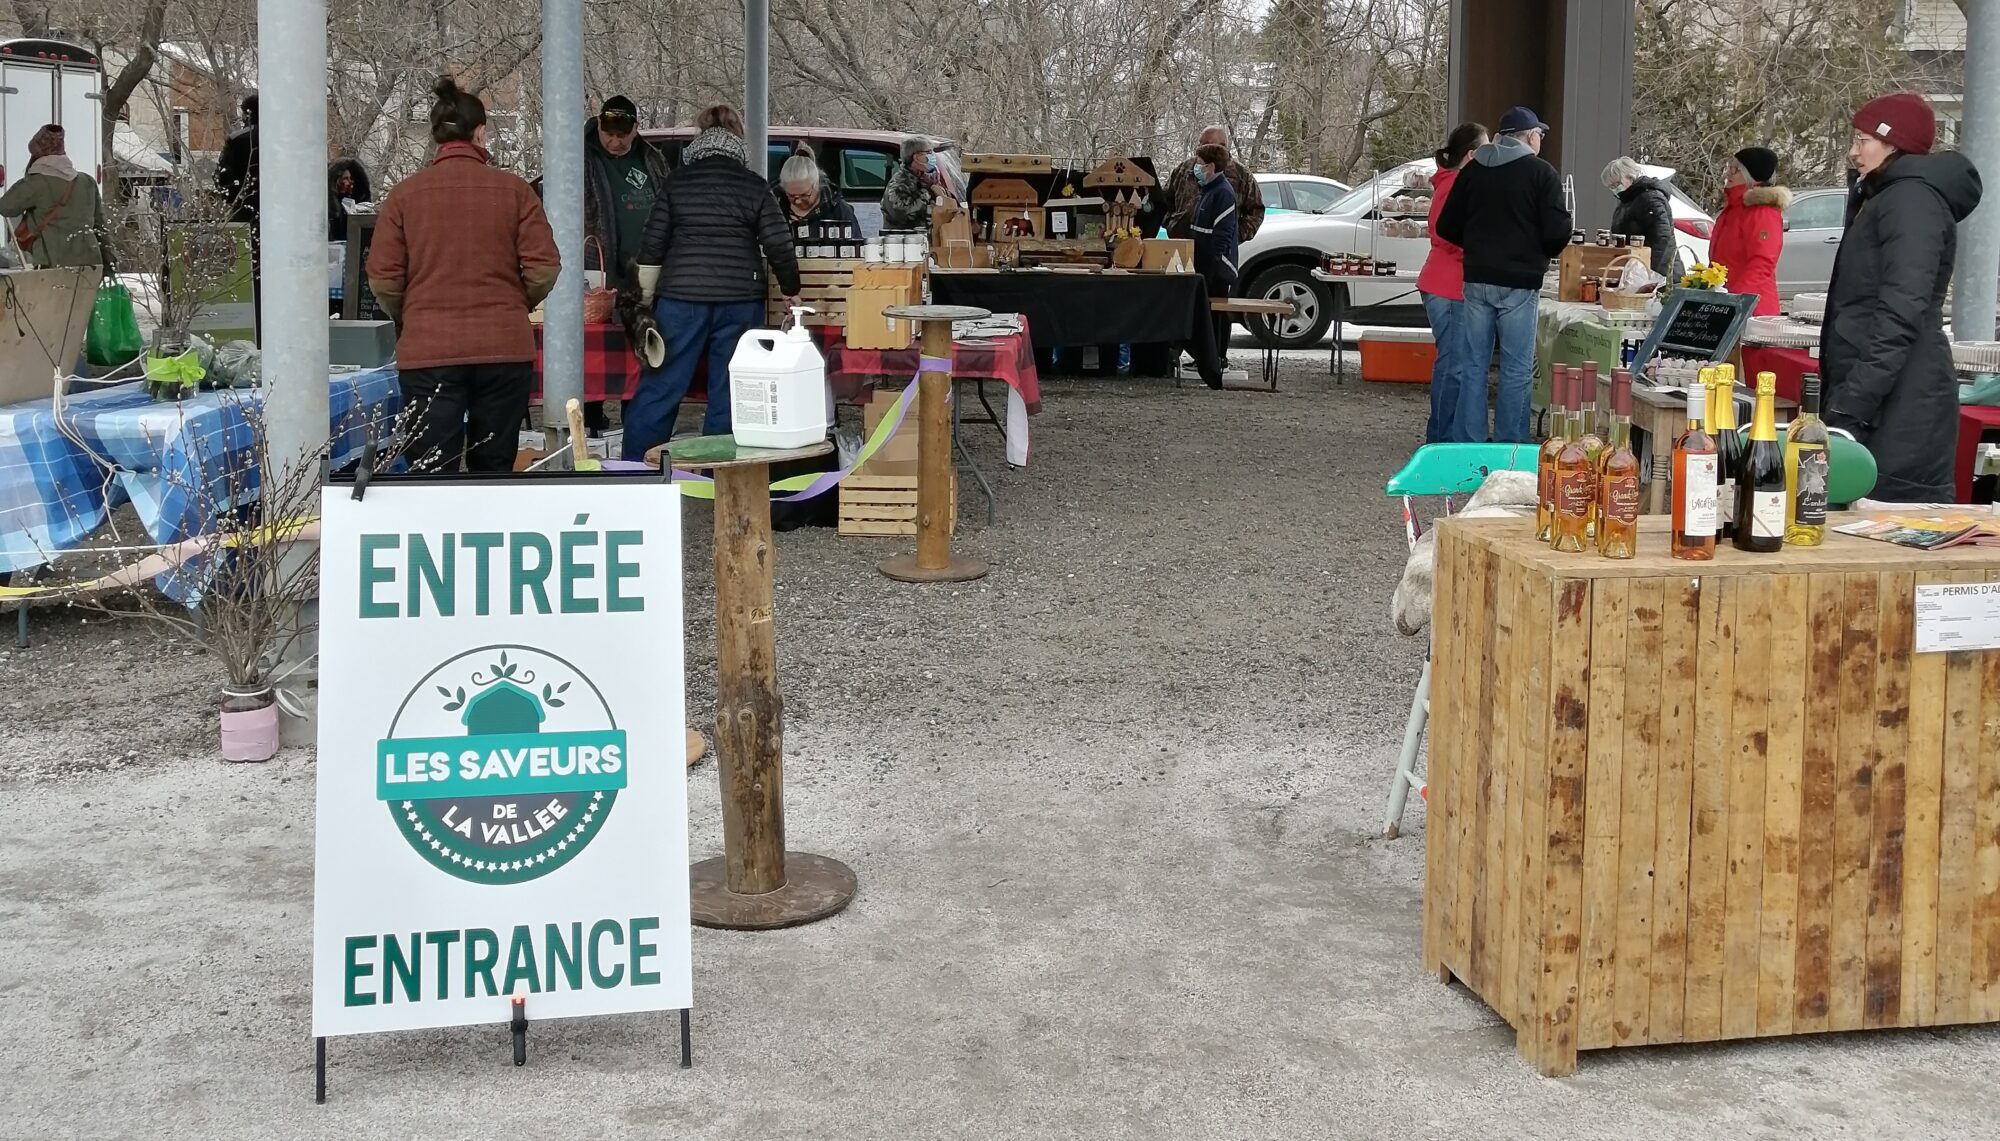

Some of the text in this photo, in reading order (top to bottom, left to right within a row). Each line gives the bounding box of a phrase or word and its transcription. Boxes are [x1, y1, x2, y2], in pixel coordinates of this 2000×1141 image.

[359, 513, 645, 619] ENTRÉE
[1942, 586, 1979, 596] PERMIS
[385, 744, 622, 783] LES SAVEURS
[441, 798, 568, 844] LA VALLÉE
[493, 803, 517, 819] DE
[344, 917, 661, 1007] ENTRANCE
